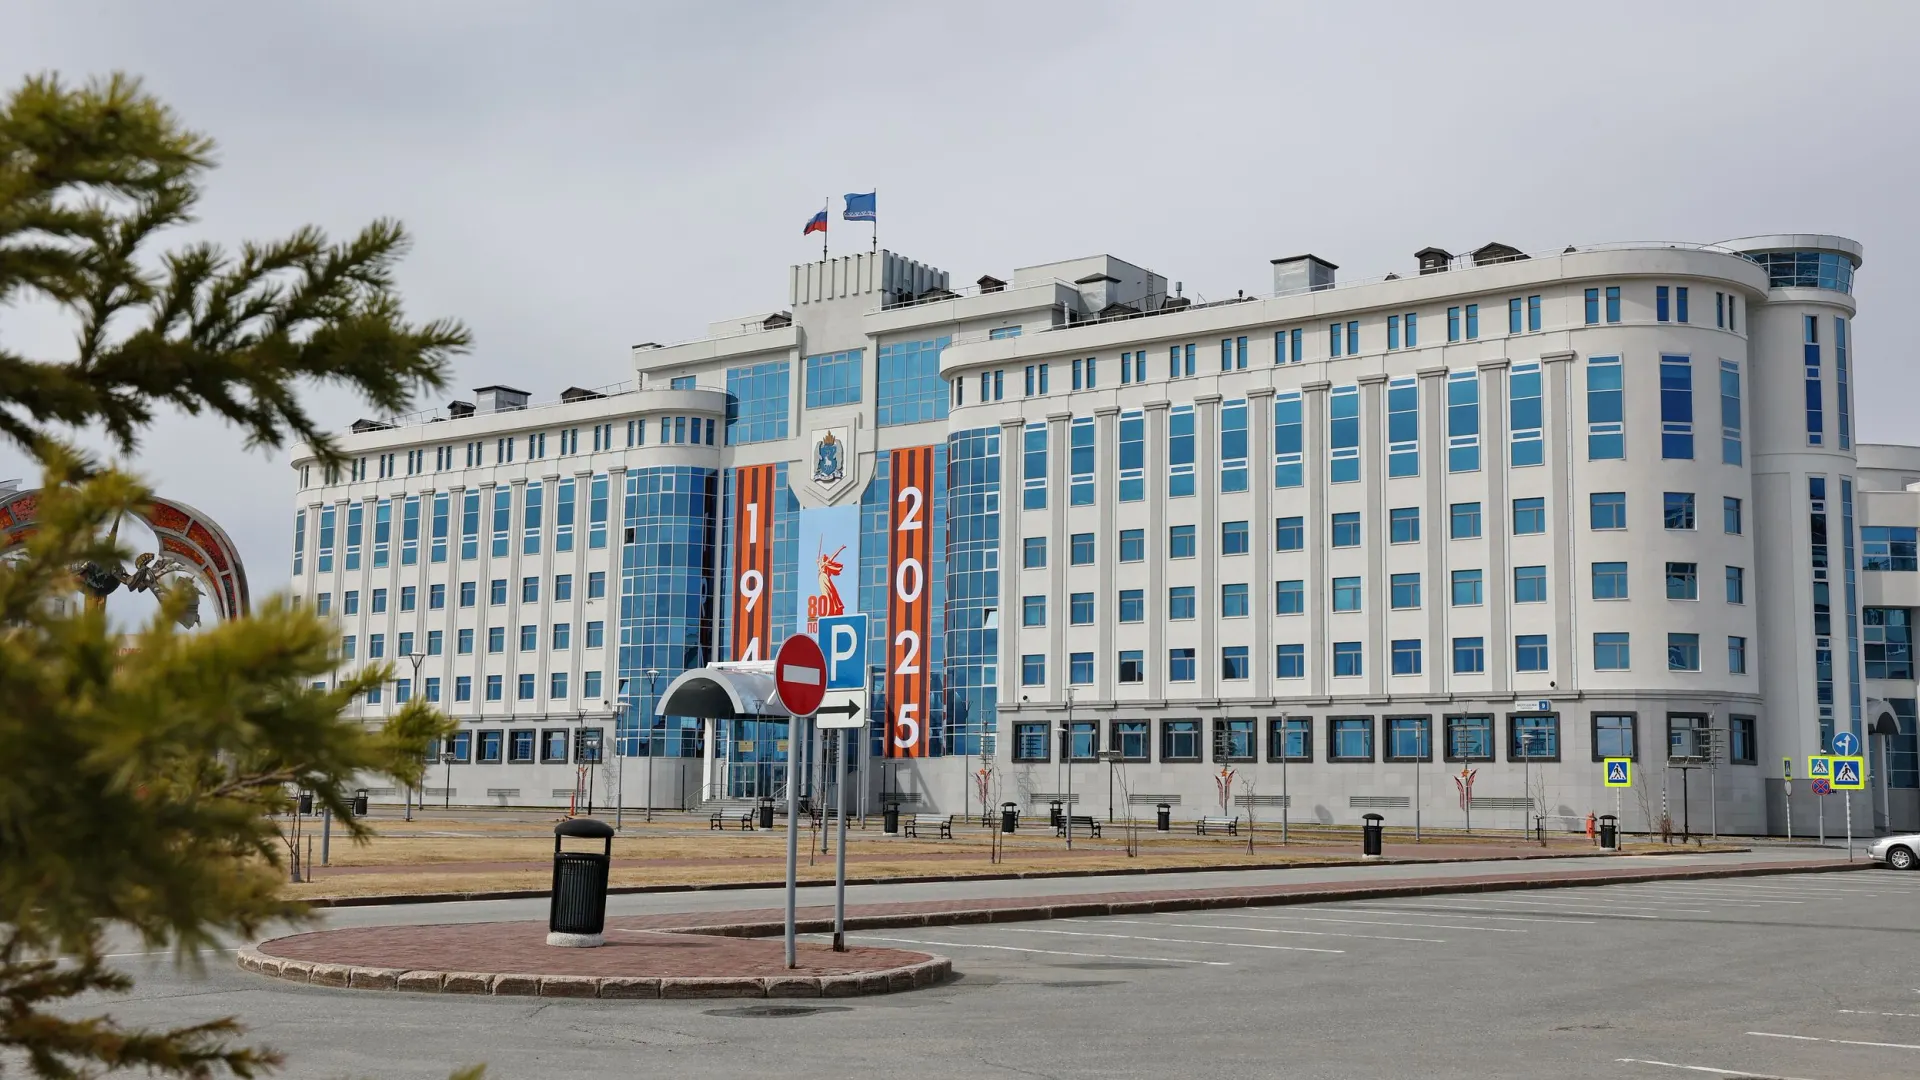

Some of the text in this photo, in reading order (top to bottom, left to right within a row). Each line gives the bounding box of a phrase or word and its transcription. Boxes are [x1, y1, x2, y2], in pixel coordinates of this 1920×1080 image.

[739, 503, 764, 662] 194
[807, 594, 829, 617] 80
[894, 486, 924, 748] 2025
[831, 624, 857, 681] P
